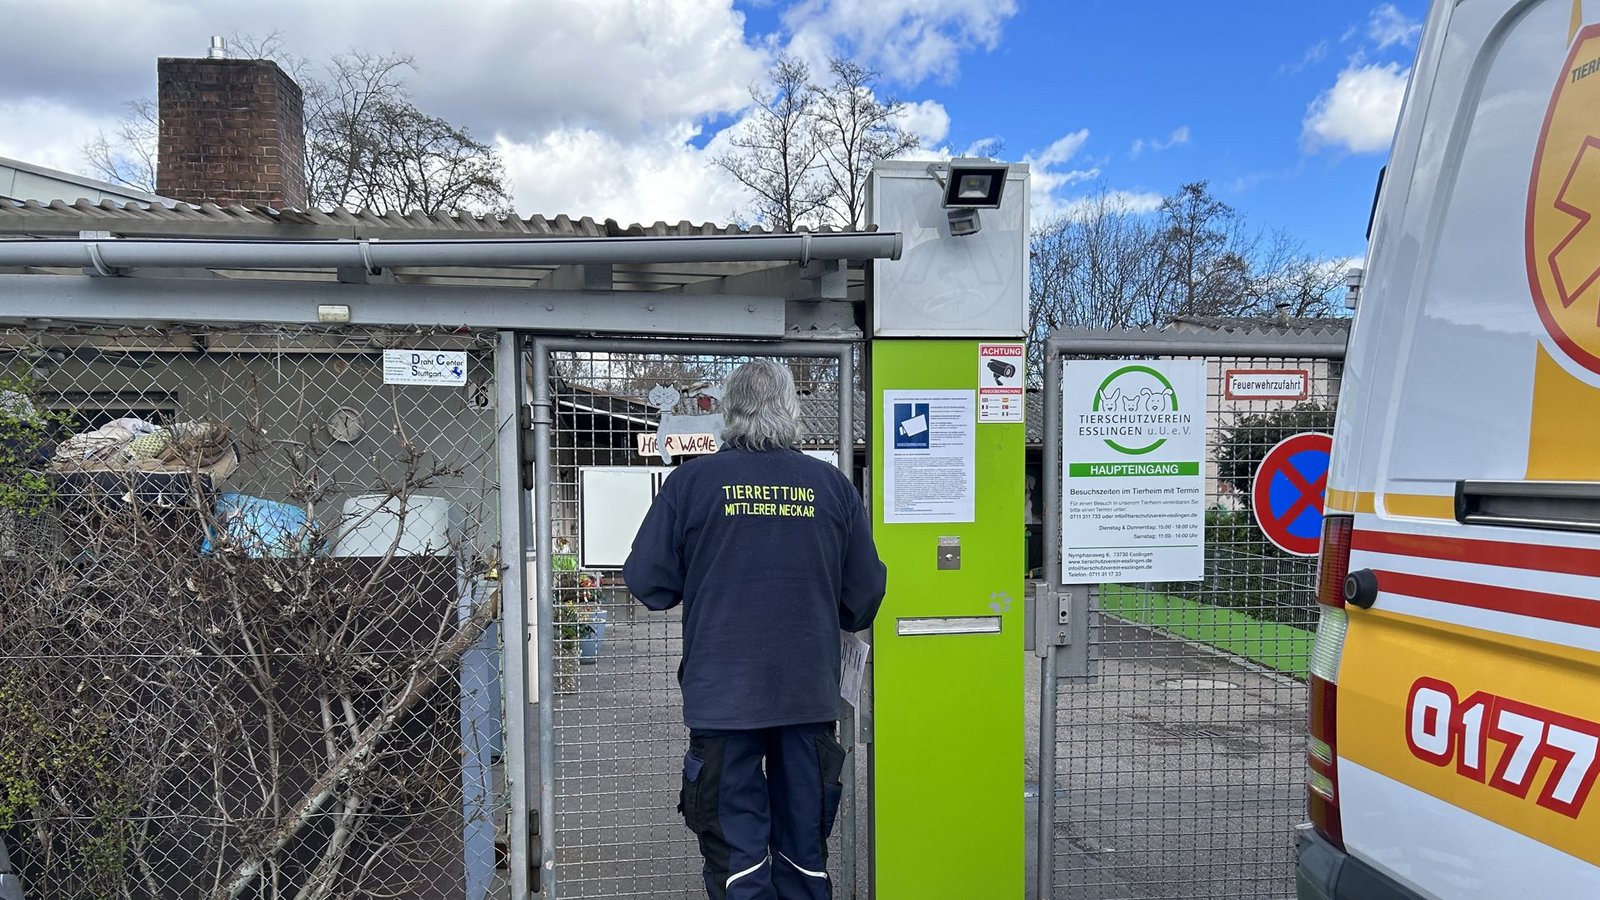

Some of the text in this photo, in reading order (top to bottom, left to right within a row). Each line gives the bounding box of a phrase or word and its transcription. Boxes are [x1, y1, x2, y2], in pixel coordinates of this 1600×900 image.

[982, 347, 1021, 356] ACHTUNG
[411, 353, 434, 366] Draht
[411, 365, 442, 378] Stuttgart
[1232, 379, 1301, 390] Feuerwehrzufahrt
[1079, 414, 1191, 424] TIERSCHUTZVEREIN
[1079, 426, 1142, 436] ESSLINGEN
[678, 436, 716, 453] WACHE
[1090, 464, 1179, 475] HAUPTEINGANG
[722, 485, 815, 502] TIERRETTUNG
[1069, 488, 1120, 496] Besuchszeiten
[1122, 487, 1131, 495] im
[1132, 487, 1162, 495] Tierheim
[725, 503, 815, 518] MITTLERER NECKAR
[1409, 685, 1600, 806] 0177
